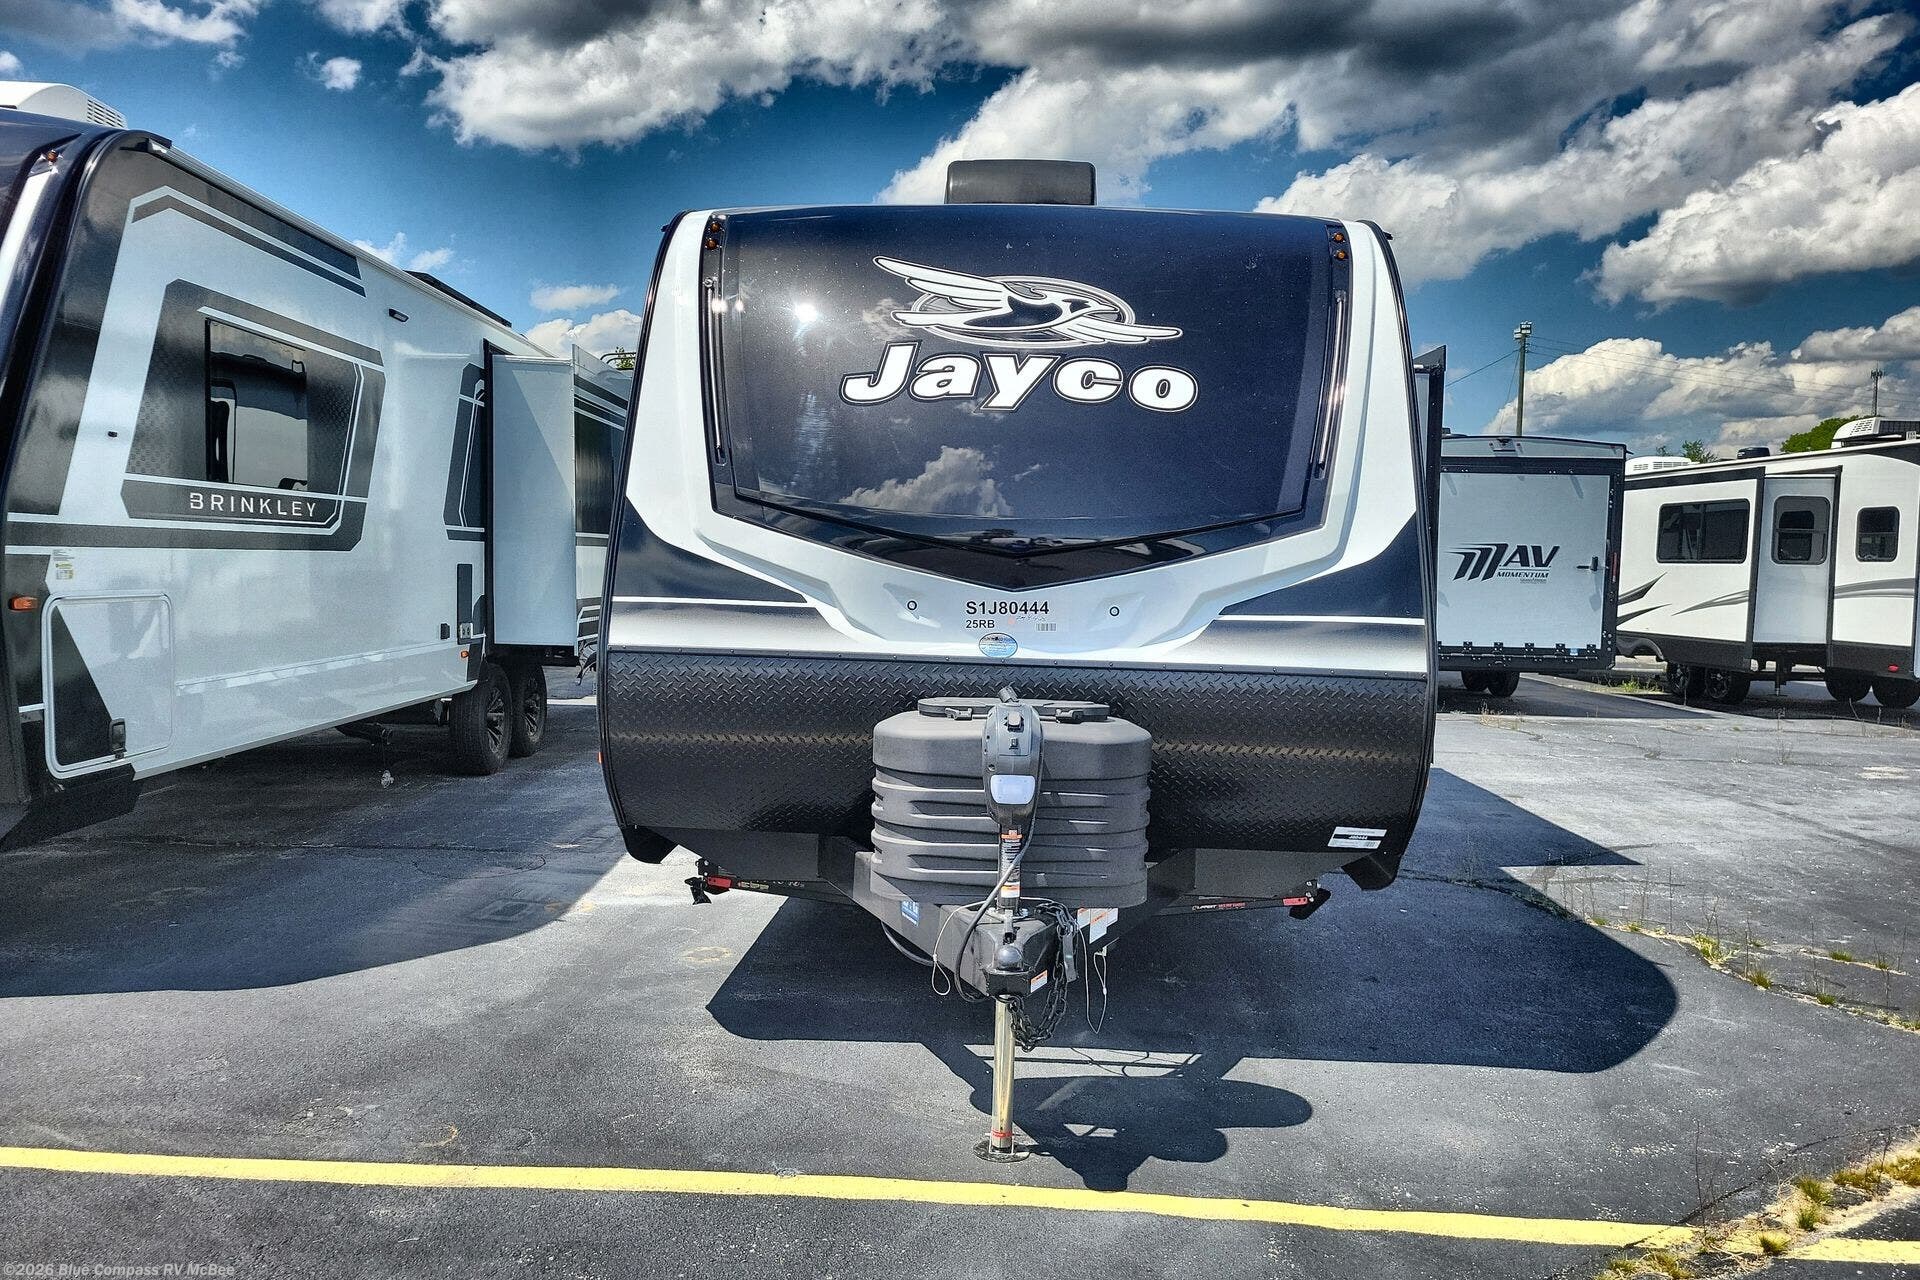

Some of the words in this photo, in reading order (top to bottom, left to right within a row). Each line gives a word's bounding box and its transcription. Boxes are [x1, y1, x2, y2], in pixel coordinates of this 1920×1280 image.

[839, 339, 1201, 413] Jayco
[189, 491, 316, 517] BRINKLEY
[1496, 571, 1550, 579] MOMENTUM
[965, 600, 1050, 615] S1J80444
[965, 619, 995, 629] 25RB
